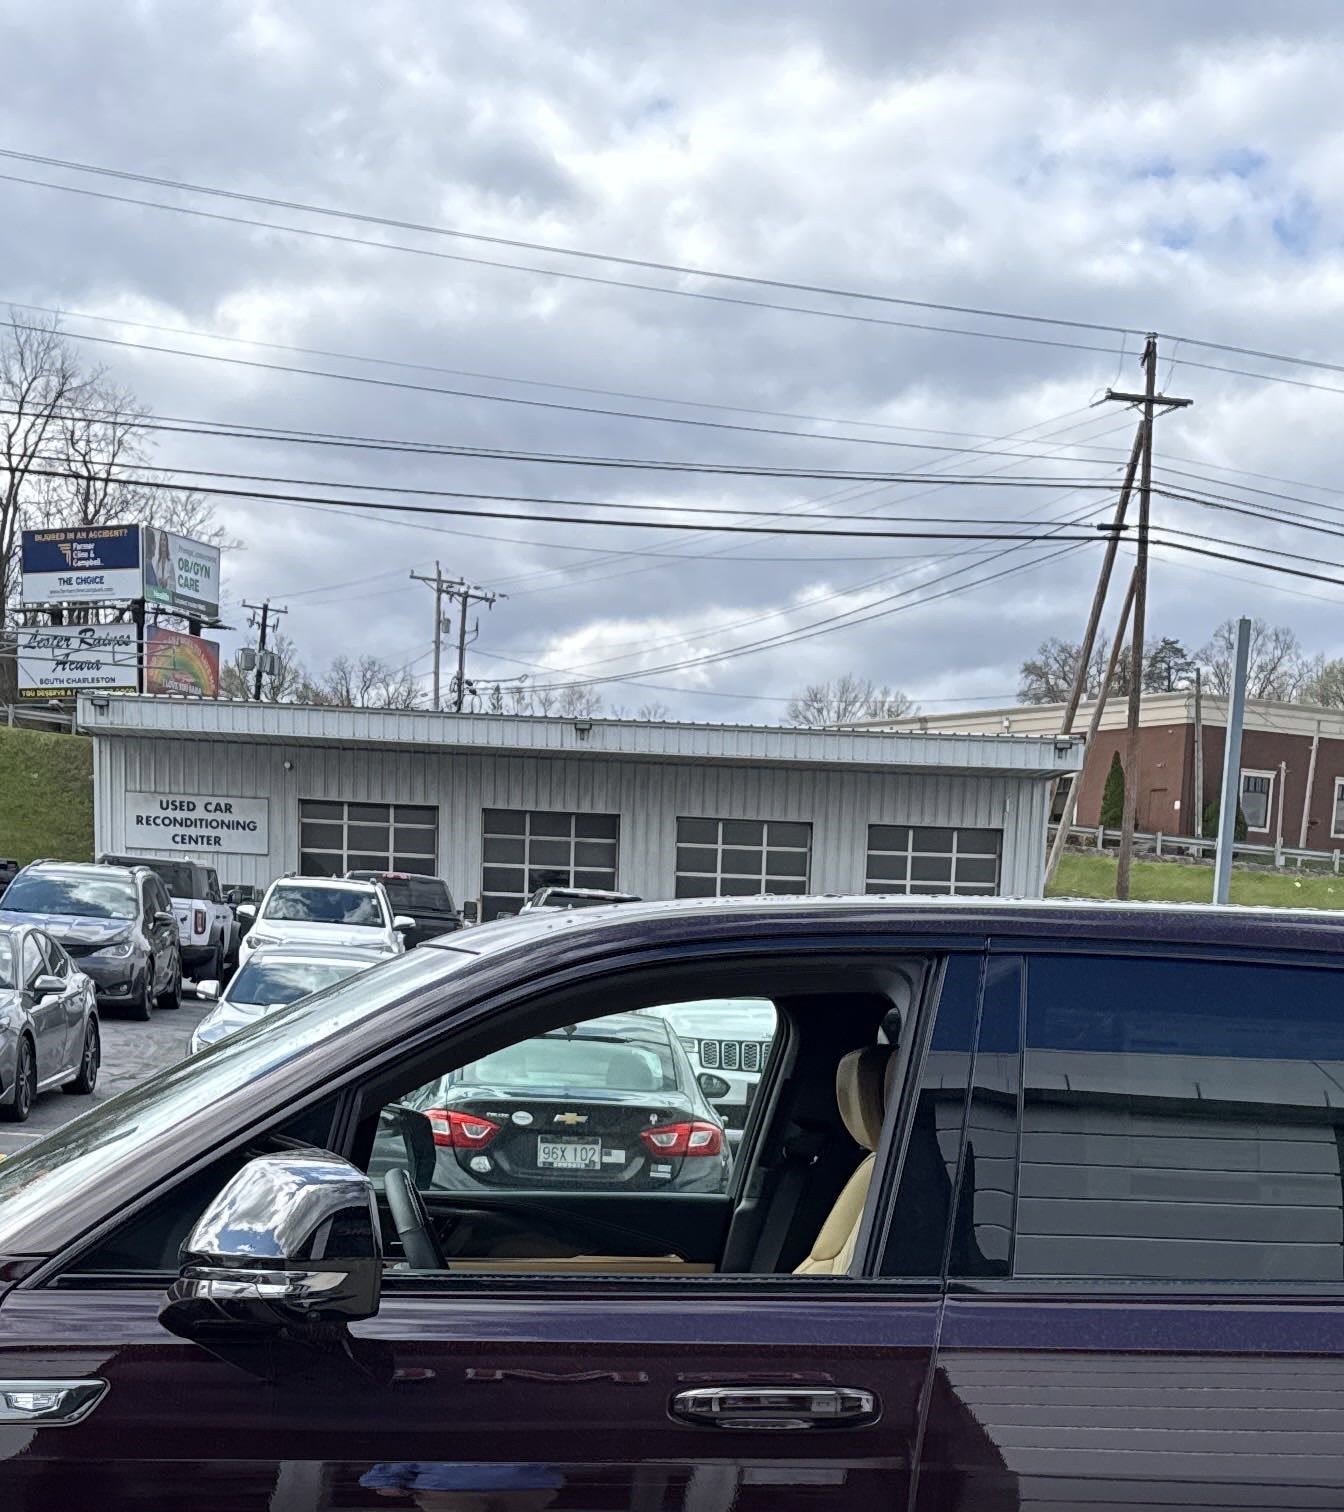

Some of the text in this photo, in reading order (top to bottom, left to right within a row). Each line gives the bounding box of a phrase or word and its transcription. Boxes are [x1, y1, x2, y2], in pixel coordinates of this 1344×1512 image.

[35, 532, 65, 542] INJURED
[88, 529, 128, 539] ACCIDENT?
[178, 557, 210, 579] OB/GYN
[58, 576, 104, 586] THE CHOICE
[177, 574, 199, 592] CARE
[66, 676, 116, 685] CHARLESTON
[21, 689, 35, 697] YOU
[160, 799, 233, 814] USED CAR
[136, 815, 257, 831] RECONDITIONING
[172, 833, 222, 846] CENTER
[543, 1146, 597, 1162] 96X 102
